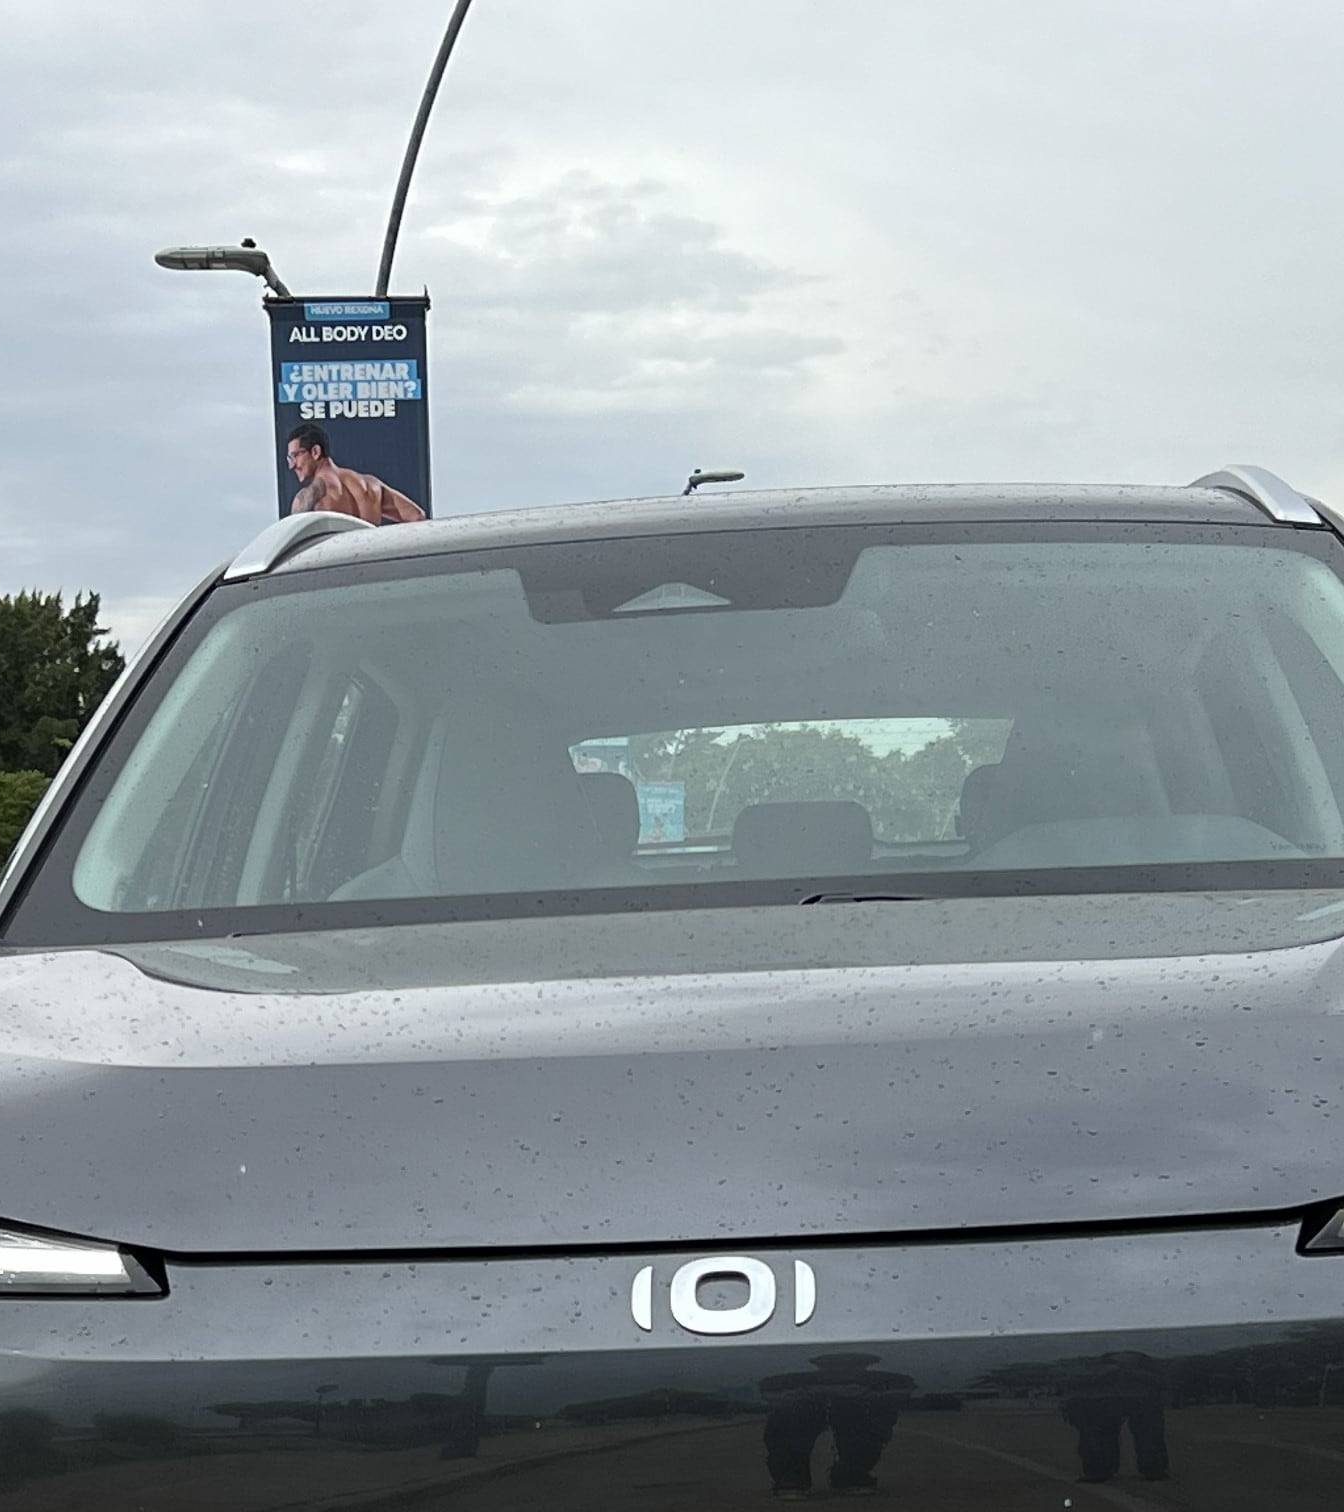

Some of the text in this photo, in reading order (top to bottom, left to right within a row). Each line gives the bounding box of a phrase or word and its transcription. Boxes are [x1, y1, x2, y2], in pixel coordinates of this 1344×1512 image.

[289, 325, 407, 342] ALL BODY DEO
[289, 362, 410, 382] ¿ENTRENAR
[283, 380, 417, 401] Y OLER BIEN?
[300, 400, 396, 419] SE PUEDE
